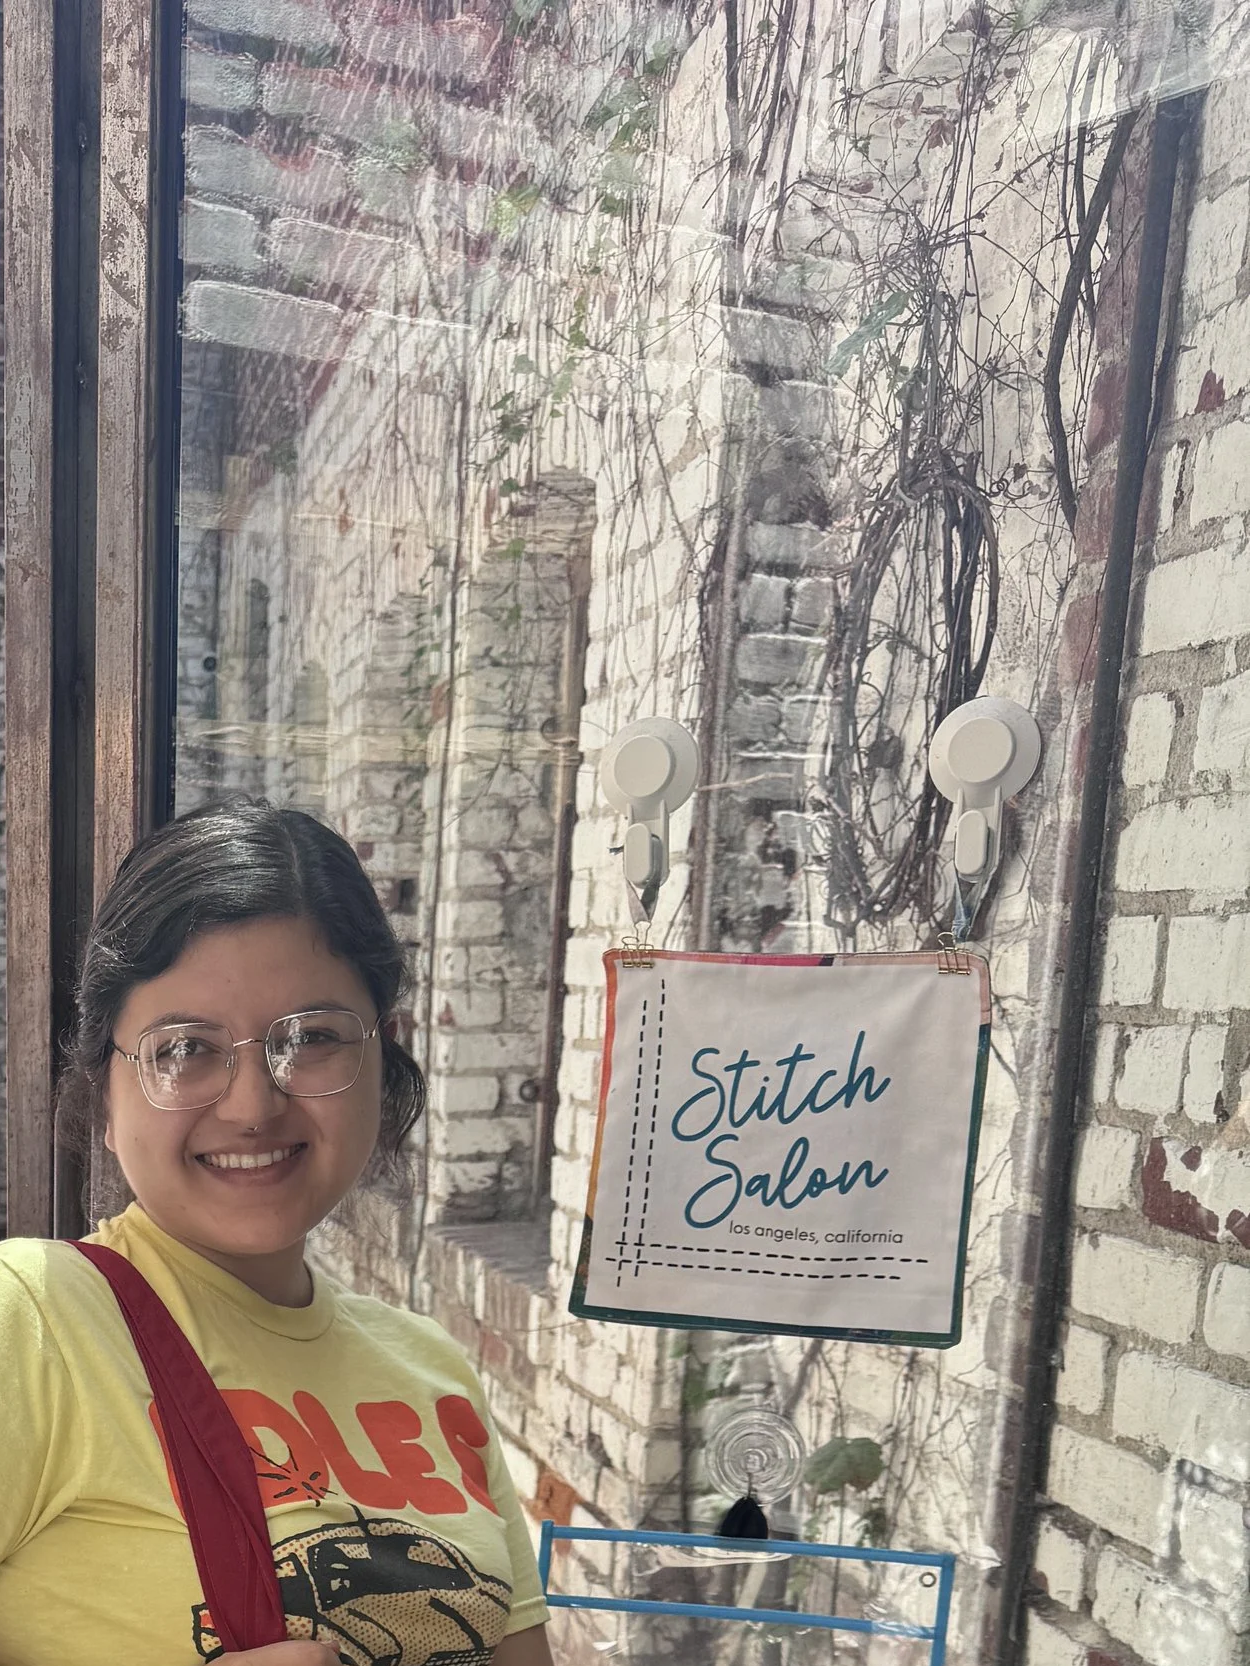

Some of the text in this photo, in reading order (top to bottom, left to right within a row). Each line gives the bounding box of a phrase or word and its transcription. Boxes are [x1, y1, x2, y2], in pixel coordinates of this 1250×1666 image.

[671, 1030, 891, 1142] Stitch
[684, 1133, 889, 1229] Salon
[729, 1220, 904, 1245] los angeles, california
